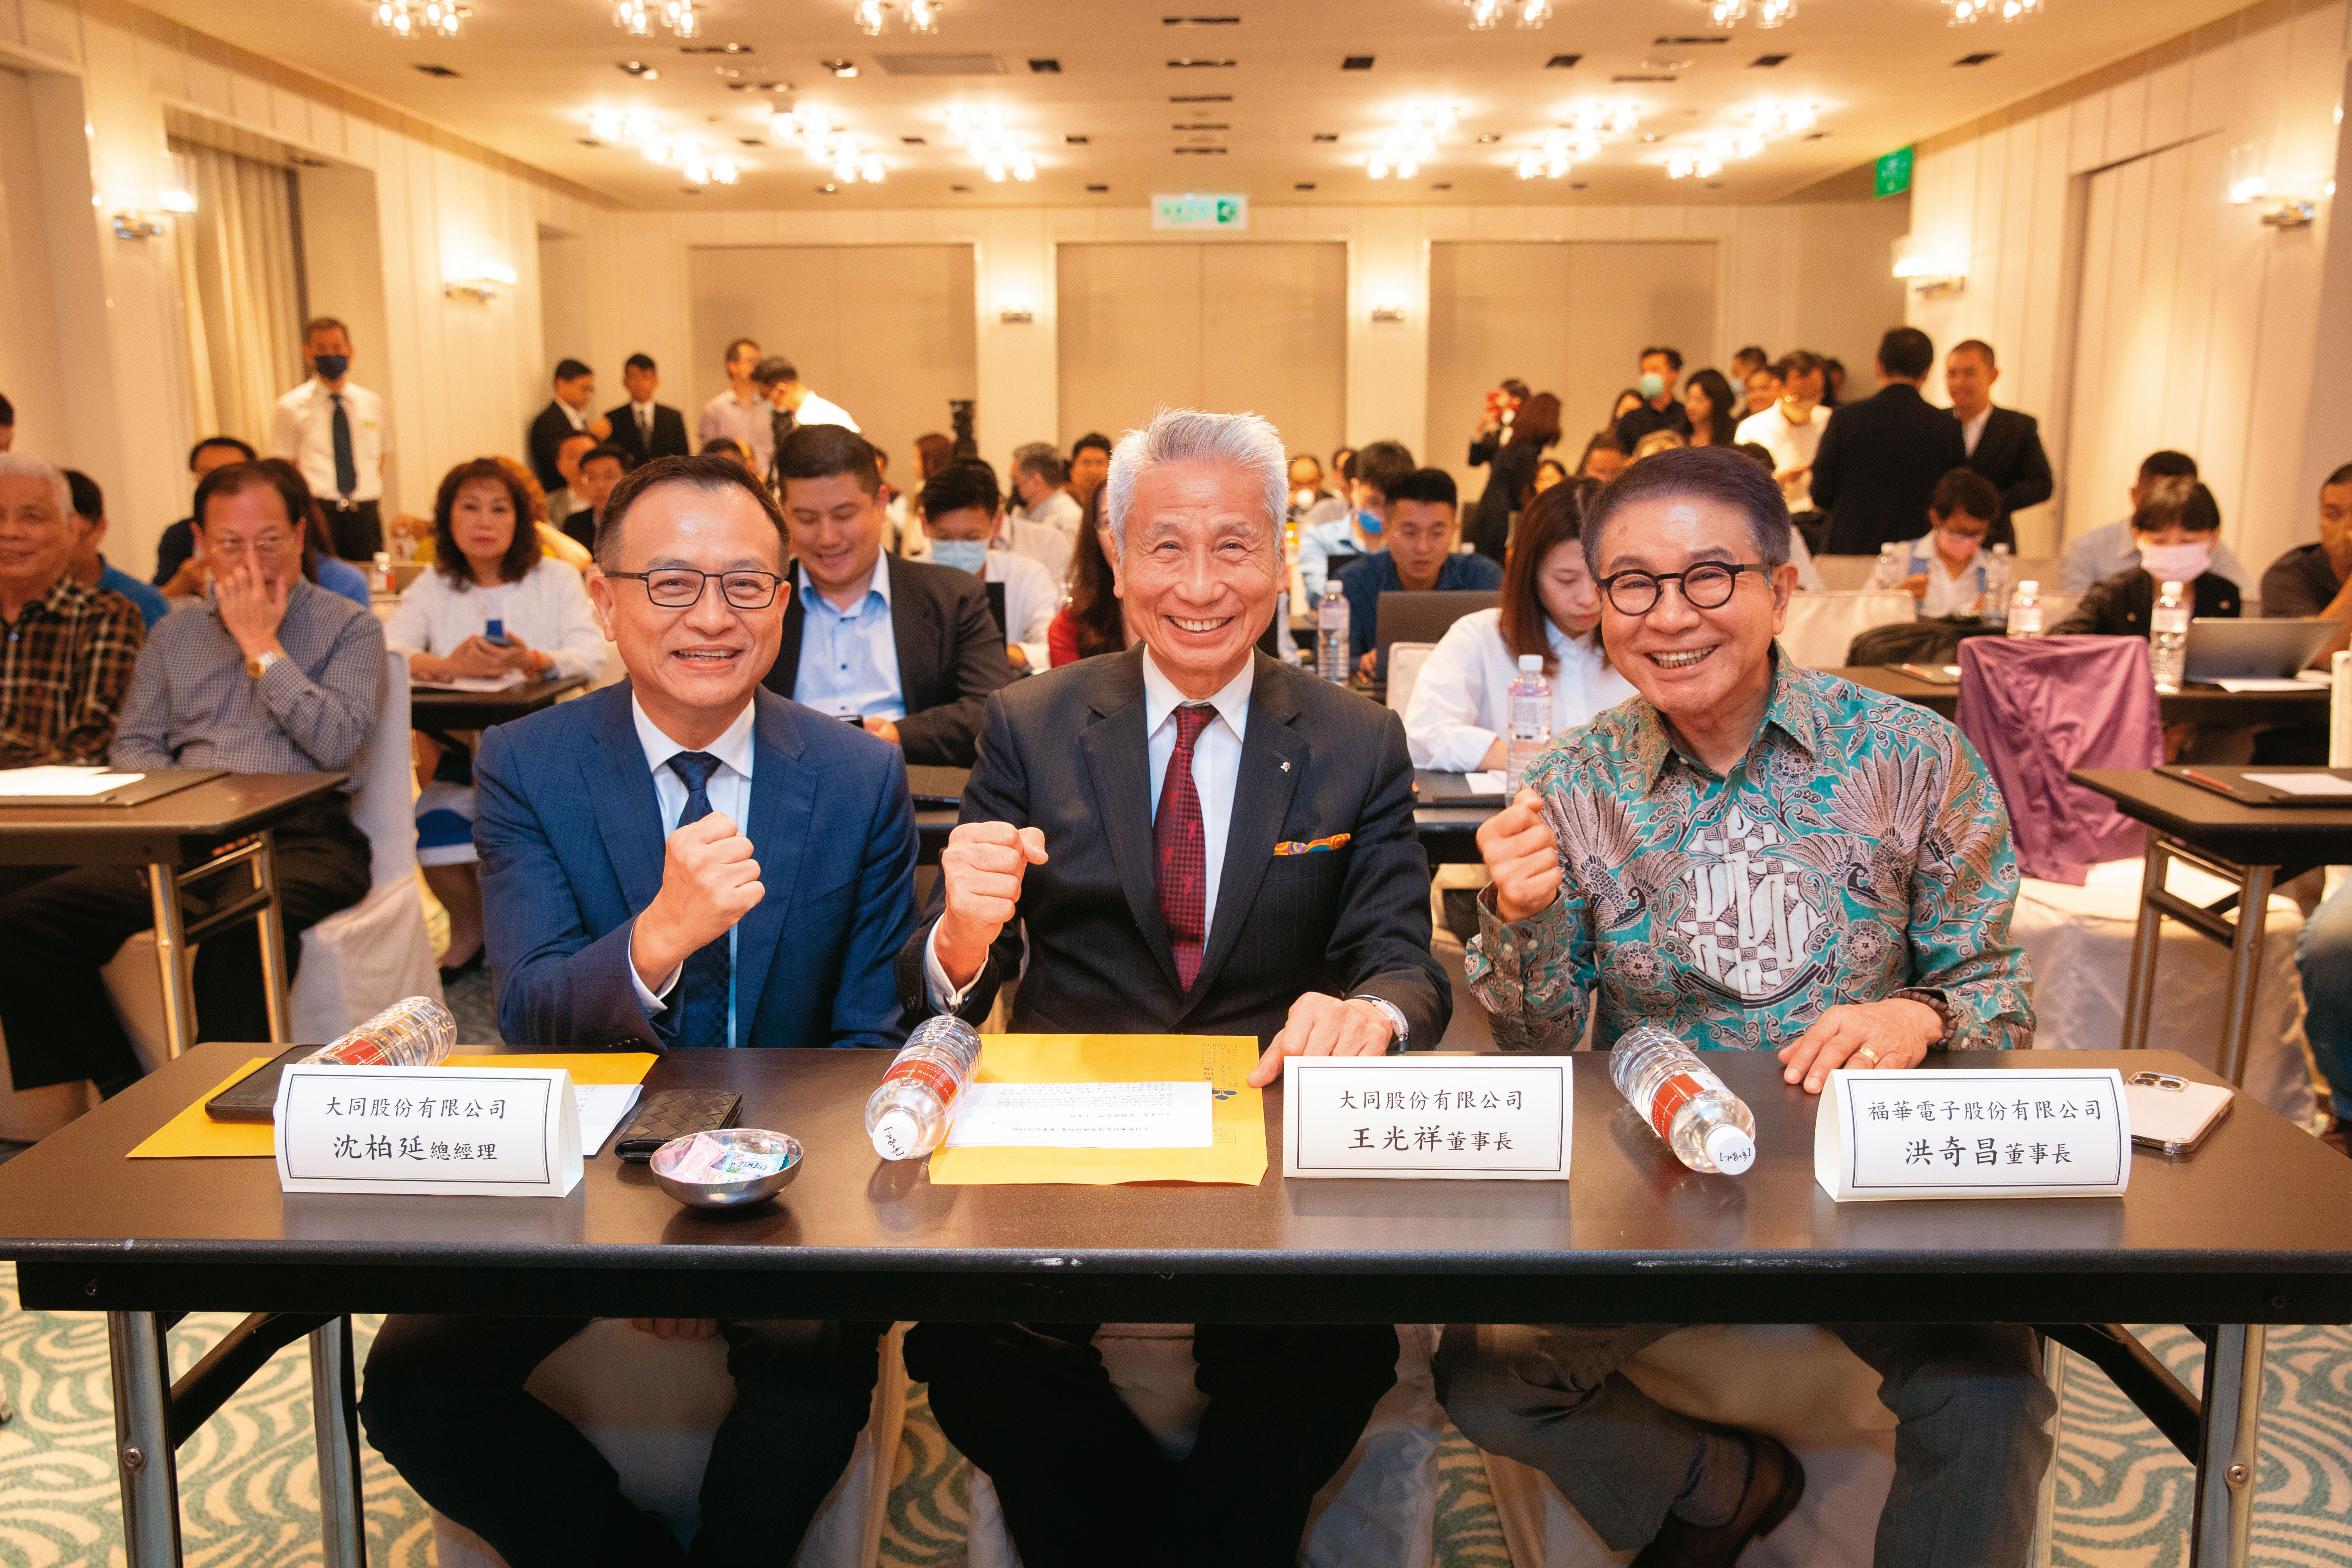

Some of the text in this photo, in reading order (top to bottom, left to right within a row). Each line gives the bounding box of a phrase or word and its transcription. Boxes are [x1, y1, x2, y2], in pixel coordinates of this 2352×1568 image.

[918, 1070, 944, 1087] Drinking
[324, 1096, 506, 1120] 大同股份有限公司
[1338, 1089, 1522, 1110] 大同股份有限公司
[1662, 1094, 1678, 1119] Mineral
[1867, 1099, 2101, 1121] 福華電子股份有限公司
